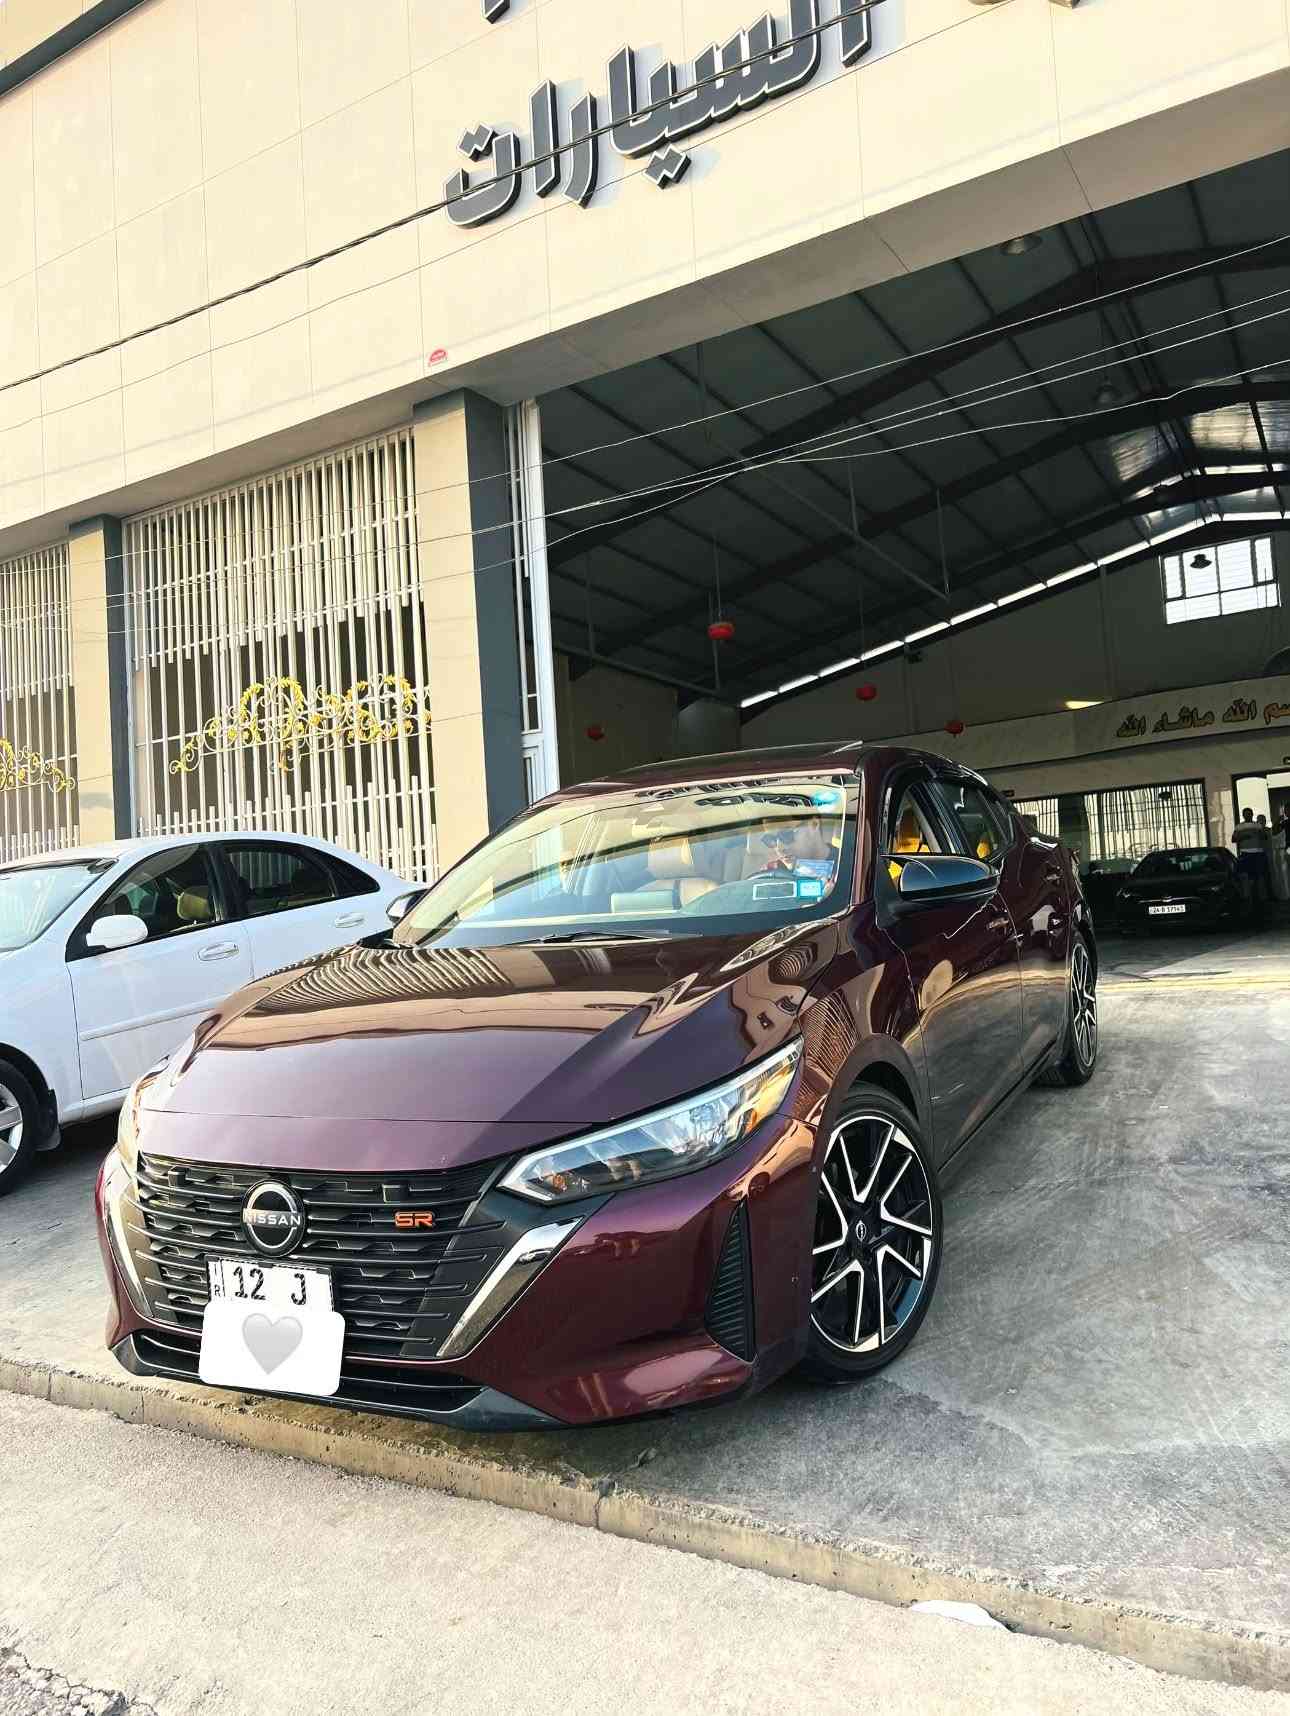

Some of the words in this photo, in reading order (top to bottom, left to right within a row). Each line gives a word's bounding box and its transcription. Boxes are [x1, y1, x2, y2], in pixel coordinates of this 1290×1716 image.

[243, 1210, 301, 1226] NISSAN
[394, 1210, 434, 1228] SR
[233, 1266, 267, 1301] 12
